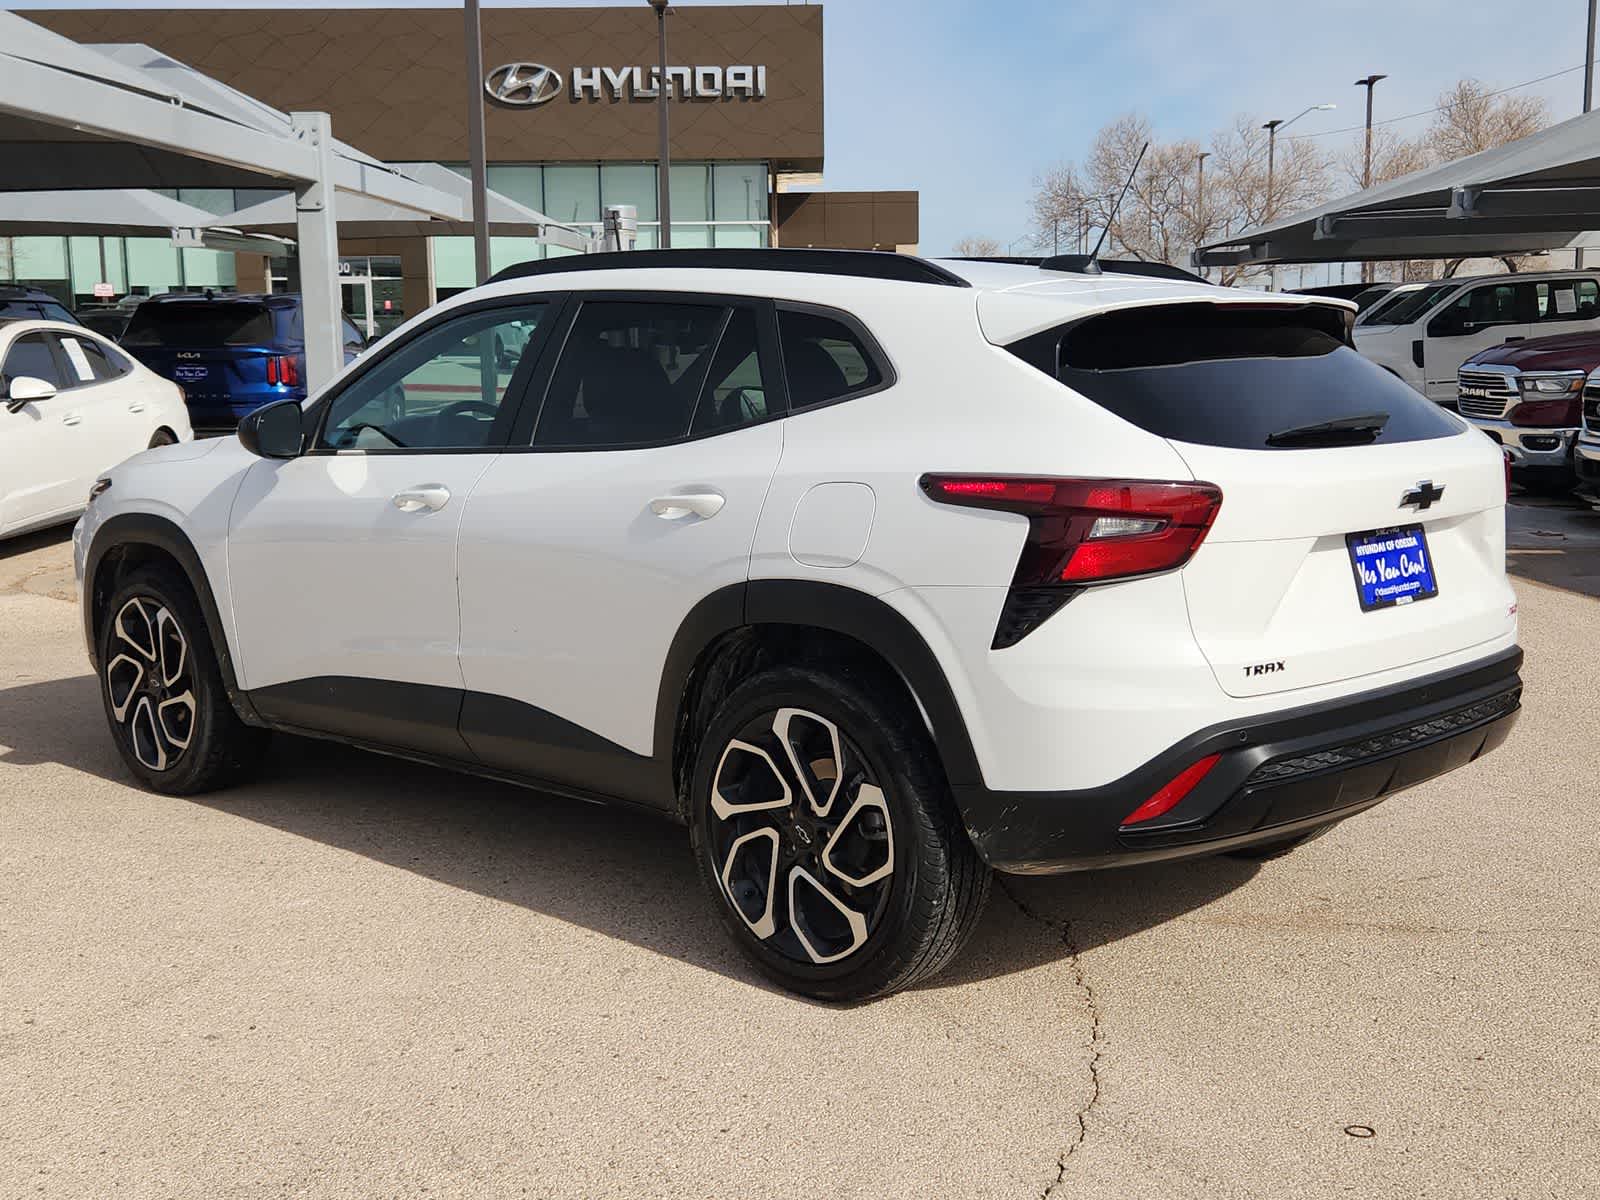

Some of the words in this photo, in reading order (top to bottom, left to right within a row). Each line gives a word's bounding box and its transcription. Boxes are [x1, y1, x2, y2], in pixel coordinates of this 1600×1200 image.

[573, 65, 766, 98] HYUNDAI
[1462, 387, 1485, 397] RAM
[1356, 541, 1386, 556] HYUNDAI
[1386, 539, 1395, 550] OF
[1395, 536, 1418, 549] ODESSA
[1356, 561, 1377, 585] Yes
[1376, 557, 1400, 582] You
[1400, 549, 1426, 577] Can!
[1243, 660, 1286, 677] TRAX
